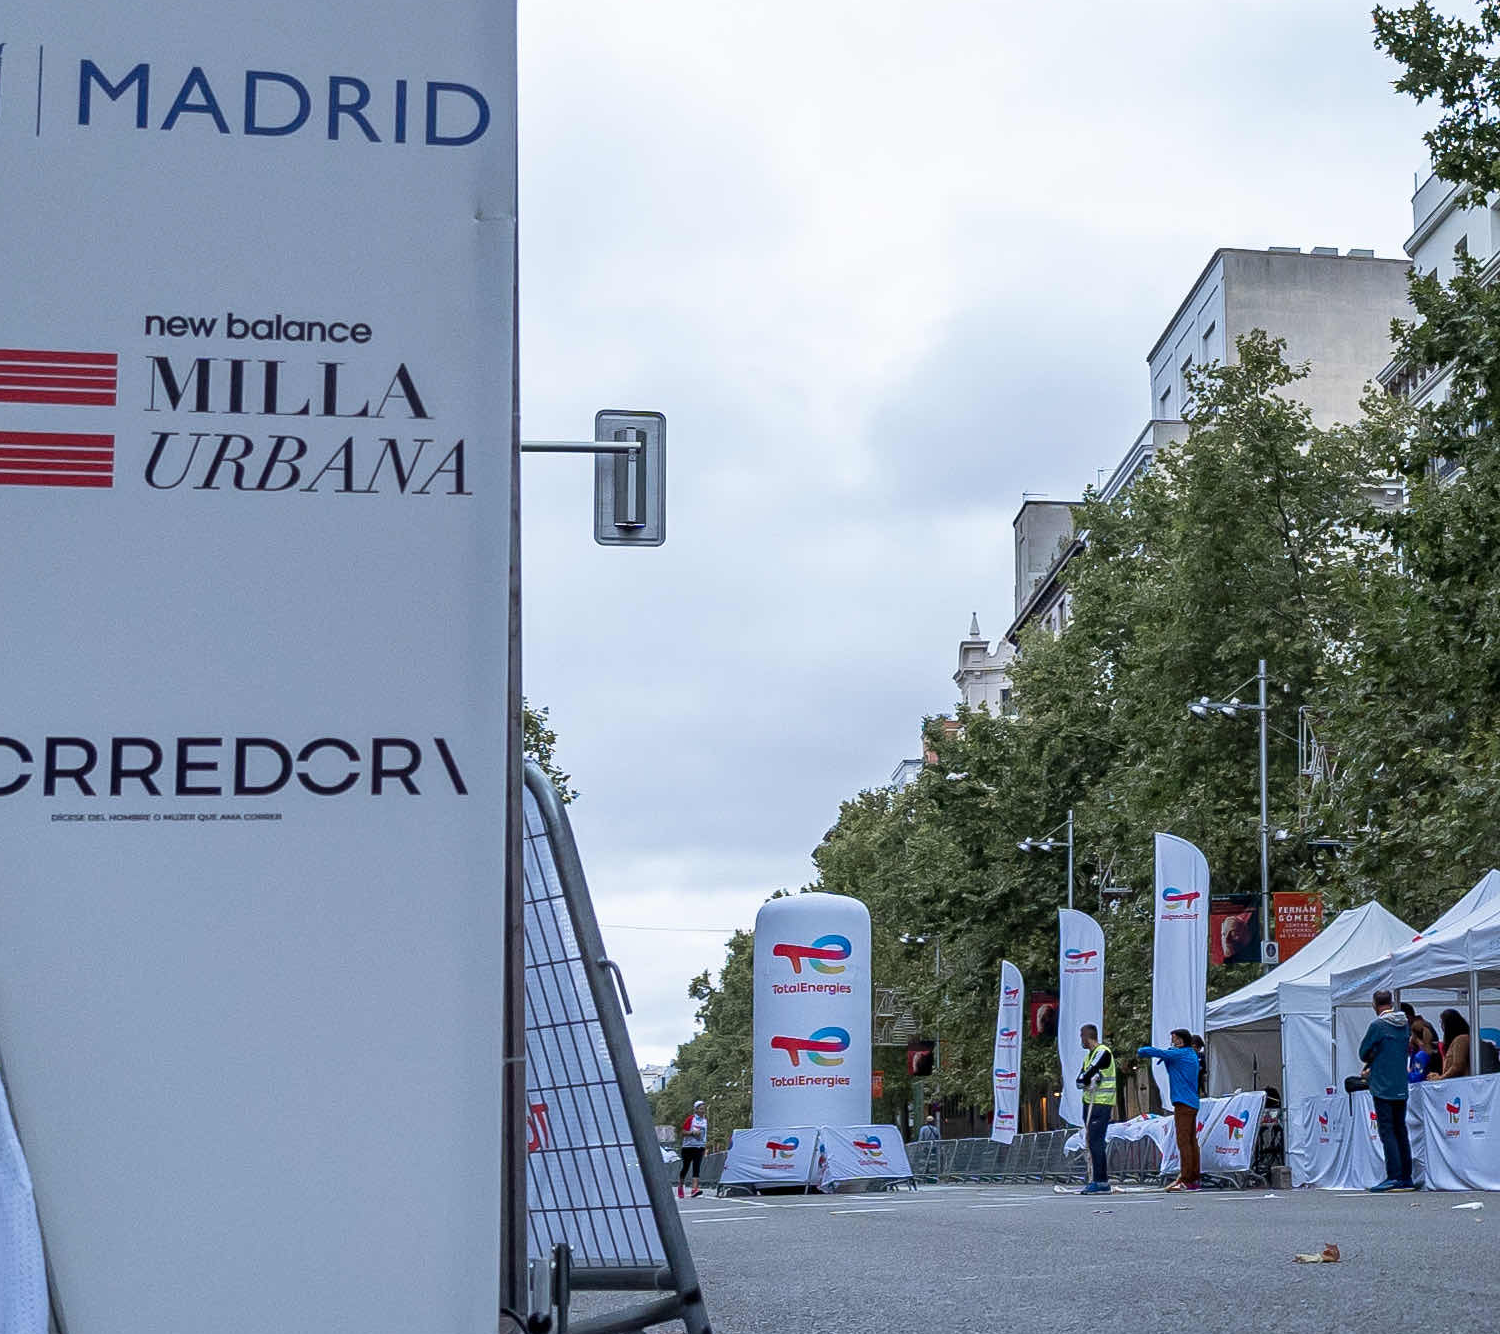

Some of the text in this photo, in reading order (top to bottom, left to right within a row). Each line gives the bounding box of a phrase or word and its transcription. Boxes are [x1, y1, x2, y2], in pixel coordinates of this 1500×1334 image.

[78, 58, 491, 147] MADRID
[144, 312, 373, 344] new balance
[143, 354, 436, 422] MILLA
[143, 431, 474, 497] URBANA
[771, 982, 852, 996] TotalEnergies
[770, 1075, 851, 1089] TotalEnergies
